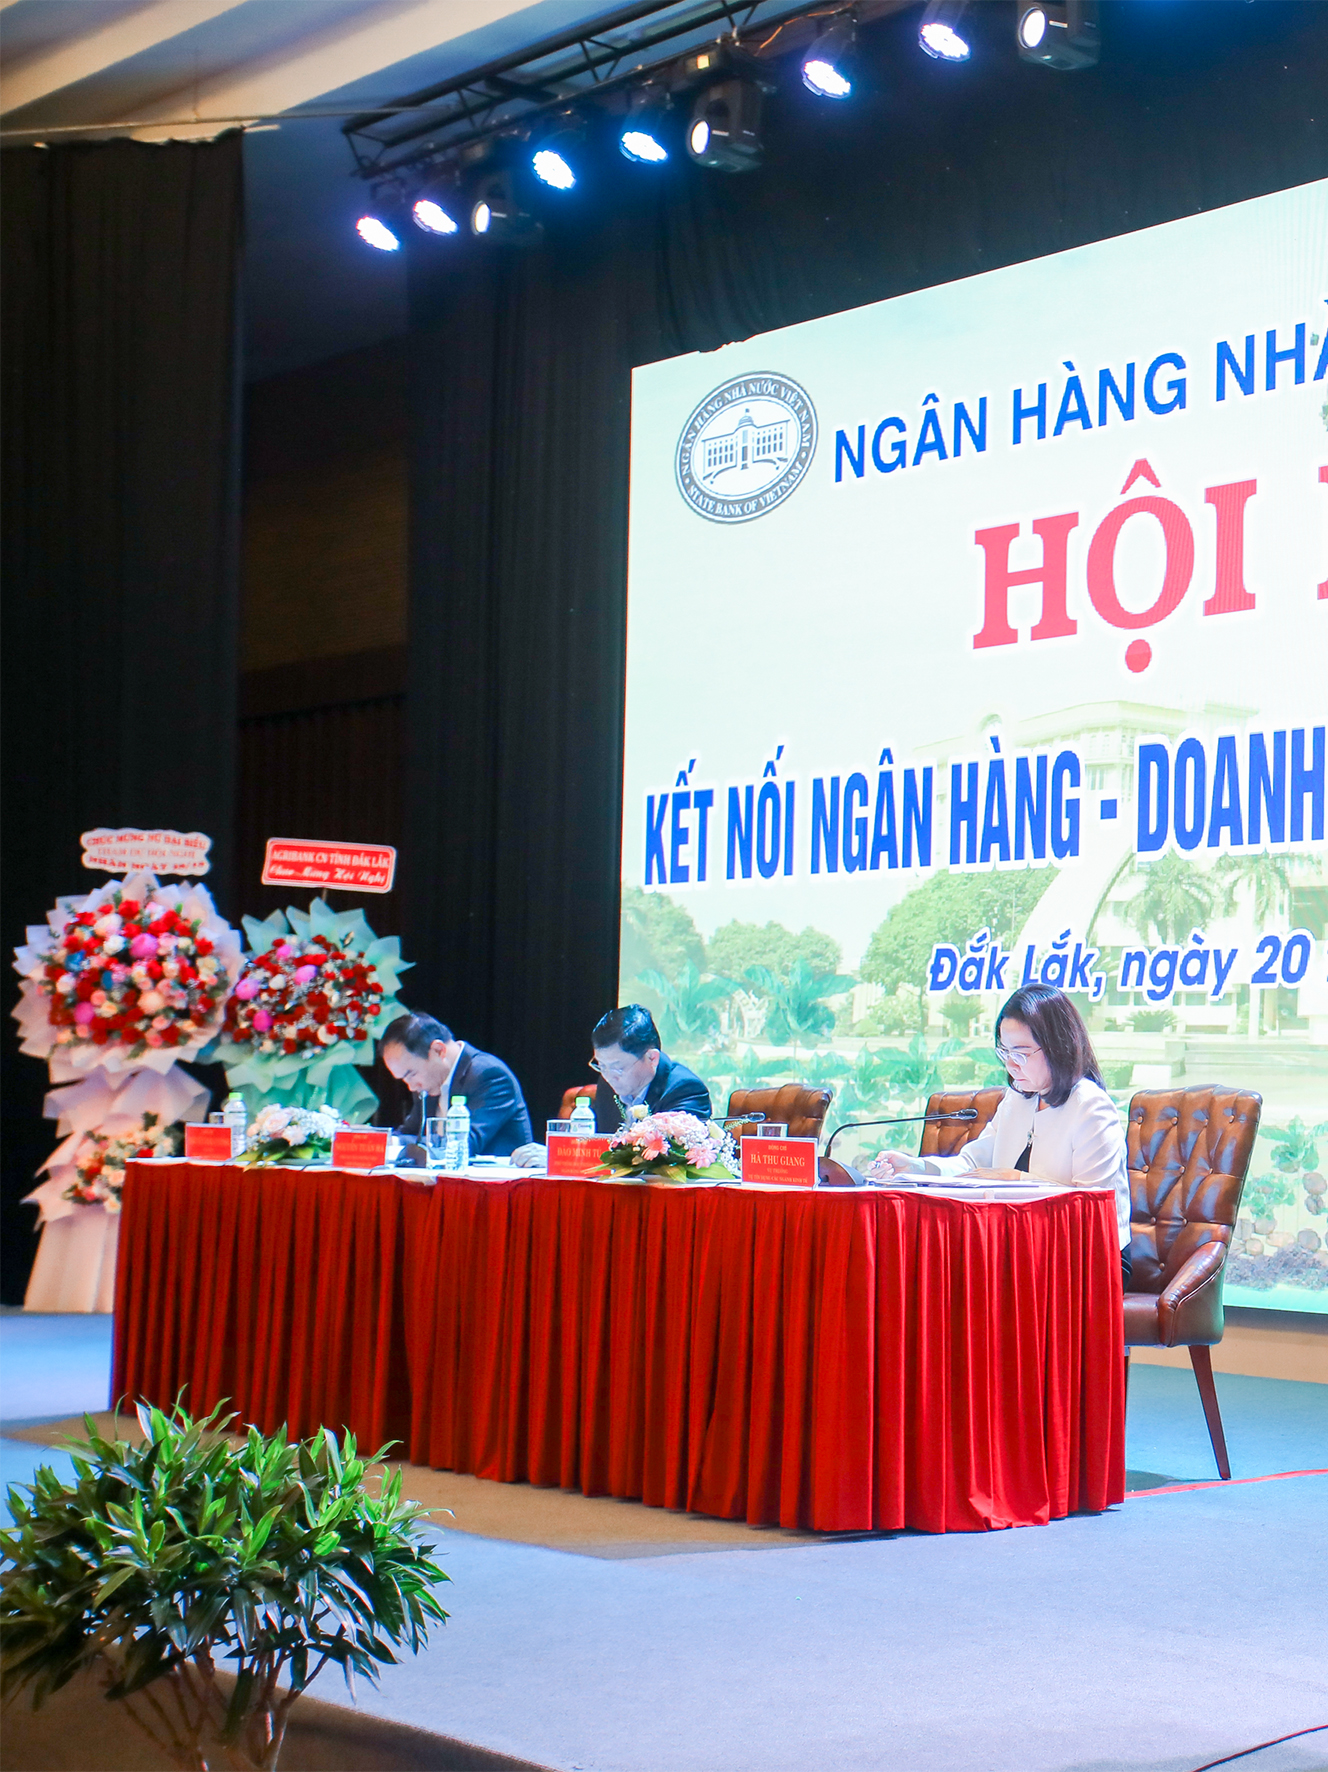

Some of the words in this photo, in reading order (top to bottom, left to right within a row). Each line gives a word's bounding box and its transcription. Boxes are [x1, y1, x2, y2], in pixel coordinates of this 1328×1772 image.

[682, 432, 697, 476] NGÂN
[695, 397, 723, 429] HÀNG
[724, 382, 747, 404] NHÀ
[749, 379, 780, 396] NƯỚC
[780, 386, 805, 410] VIỆT
[799, 409, 812, 448] NAM
[835, 392, 988, 483] NGÂN
[1012, 360, 1187, 445] HÀNG
[688, 485, 715, 512] STATE
[715, 503, 744, 516] BANK
[744, 499, 758, 513] OF
[759, 461, 804, 506] VIETNAM
[972, 458, 1257, 674] HỘI
[644, 757, 714, 886] KẾT
[726, 744, 796, 880] NỐI
[810, 747, 933, 875] NGÂN
[949, 735, 1081, 866] HÀNG
[1137, 728, 1326, 853] DOANH
[272, 850, 315, 863] AGRIBANK
[929, 931, 1009, 991] Đắk
[1020, 929, 1103, 998] Lắk,
[1121, 934, 1239, 1001] ngày
[1250, 934, 1311, 984] 20
[762, 1154, 779, 1165] THU
[780, 1156, 805, 1167] GIANG
